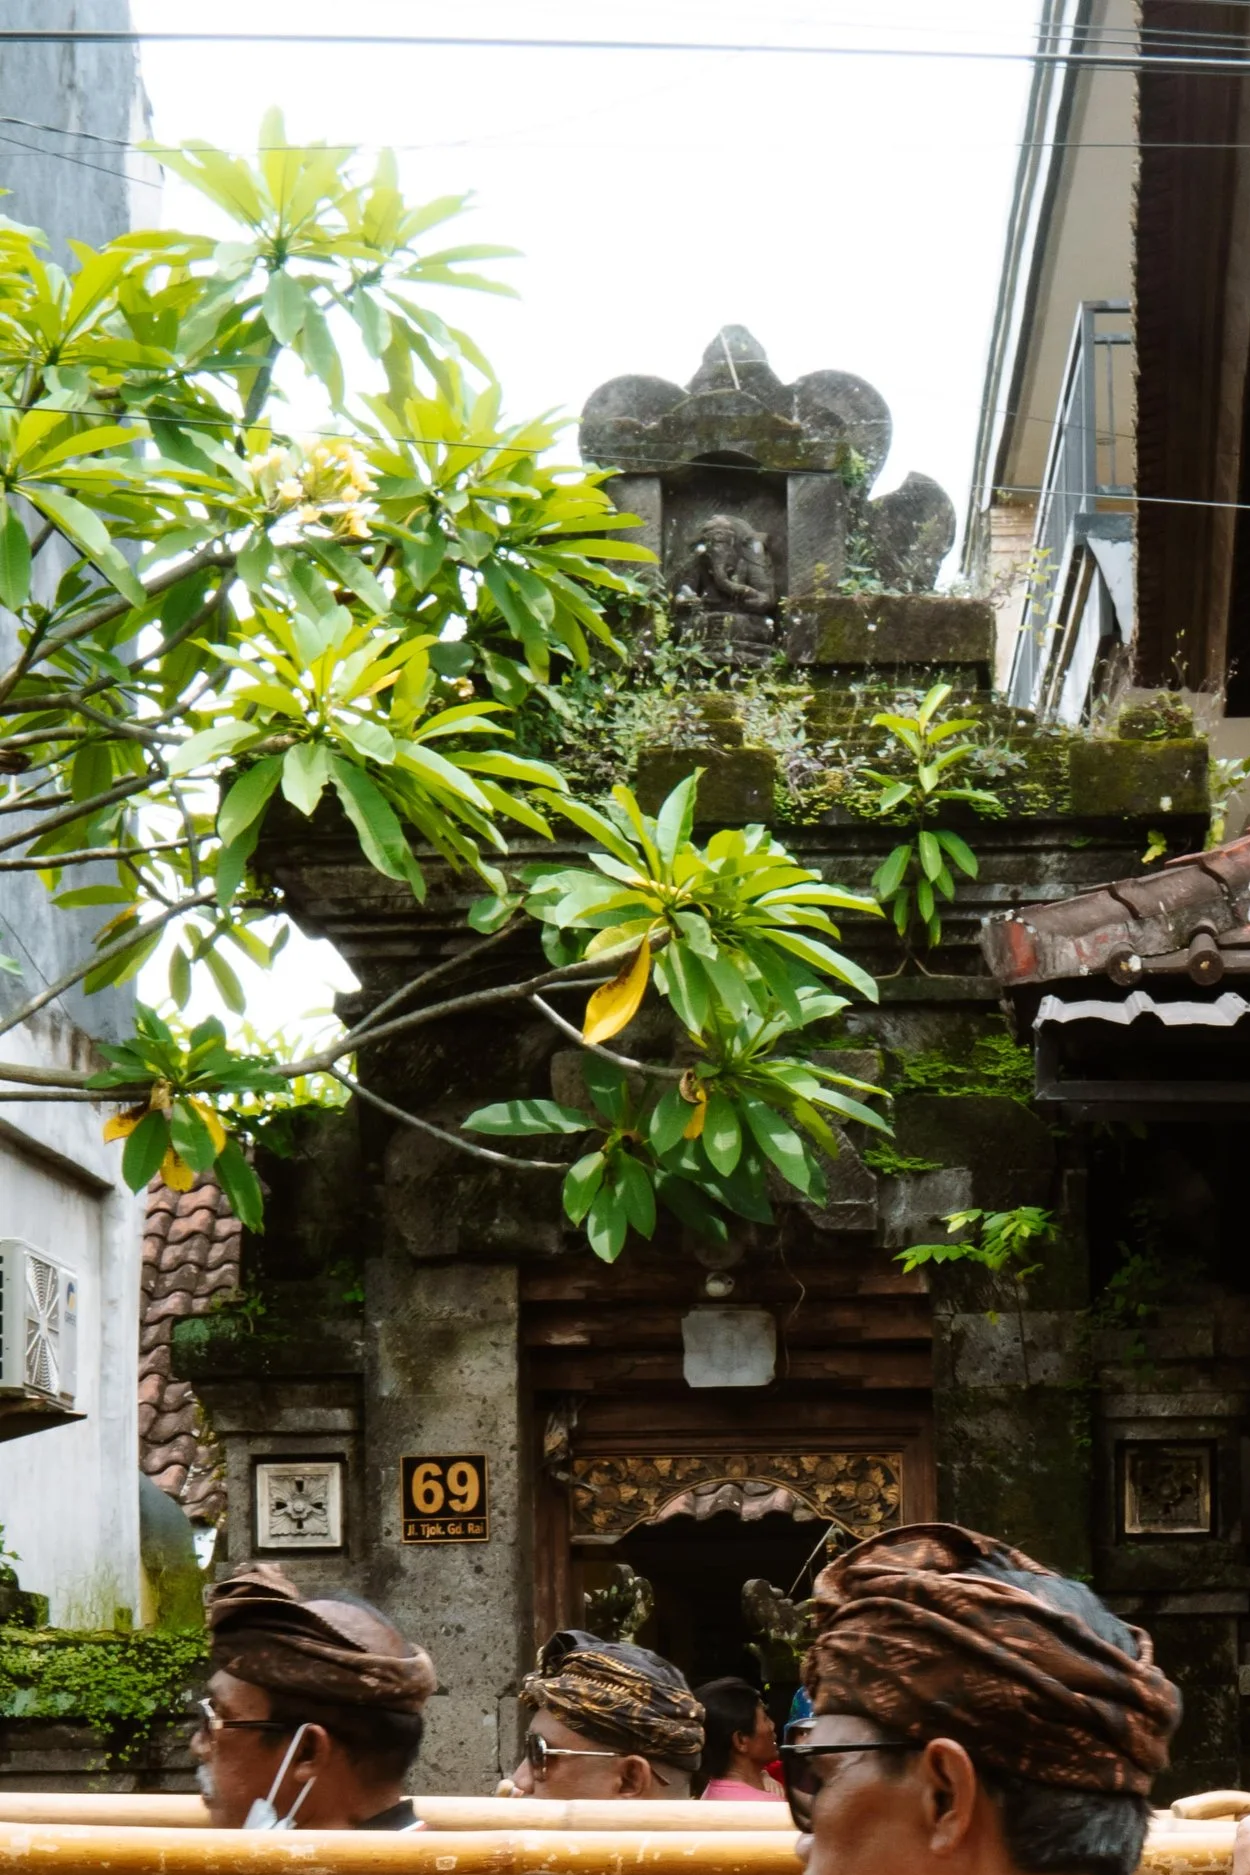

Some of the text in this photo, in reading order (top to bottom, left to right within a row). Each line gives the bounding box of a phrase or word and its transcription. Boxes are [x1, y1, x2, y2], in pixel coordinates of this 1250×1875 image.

[411, 1461, 480, 1514] 69
[420, 1522, 446, 1538] Tjok.
[467, 1521, 484, 1534] Rai
